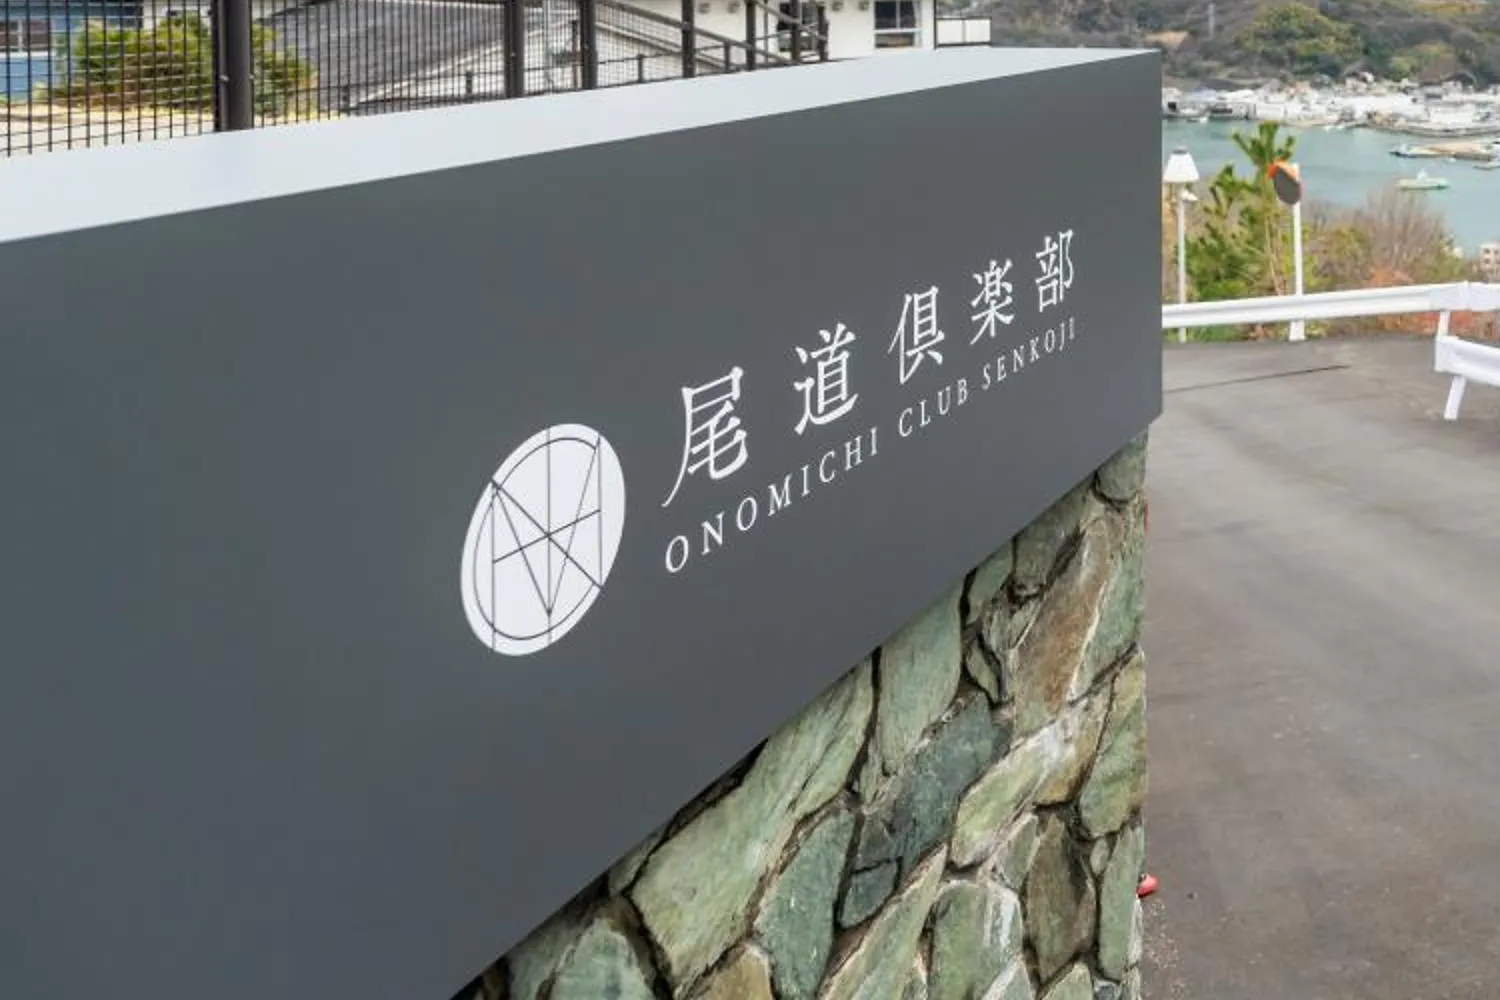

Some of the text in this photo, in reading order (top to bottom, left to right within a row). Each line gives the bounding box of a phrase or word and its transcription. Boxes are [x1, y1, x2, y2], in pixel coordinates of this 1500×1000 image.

[664, 316, 1077, 574] ONOMICHI CLUB SENKOJI
